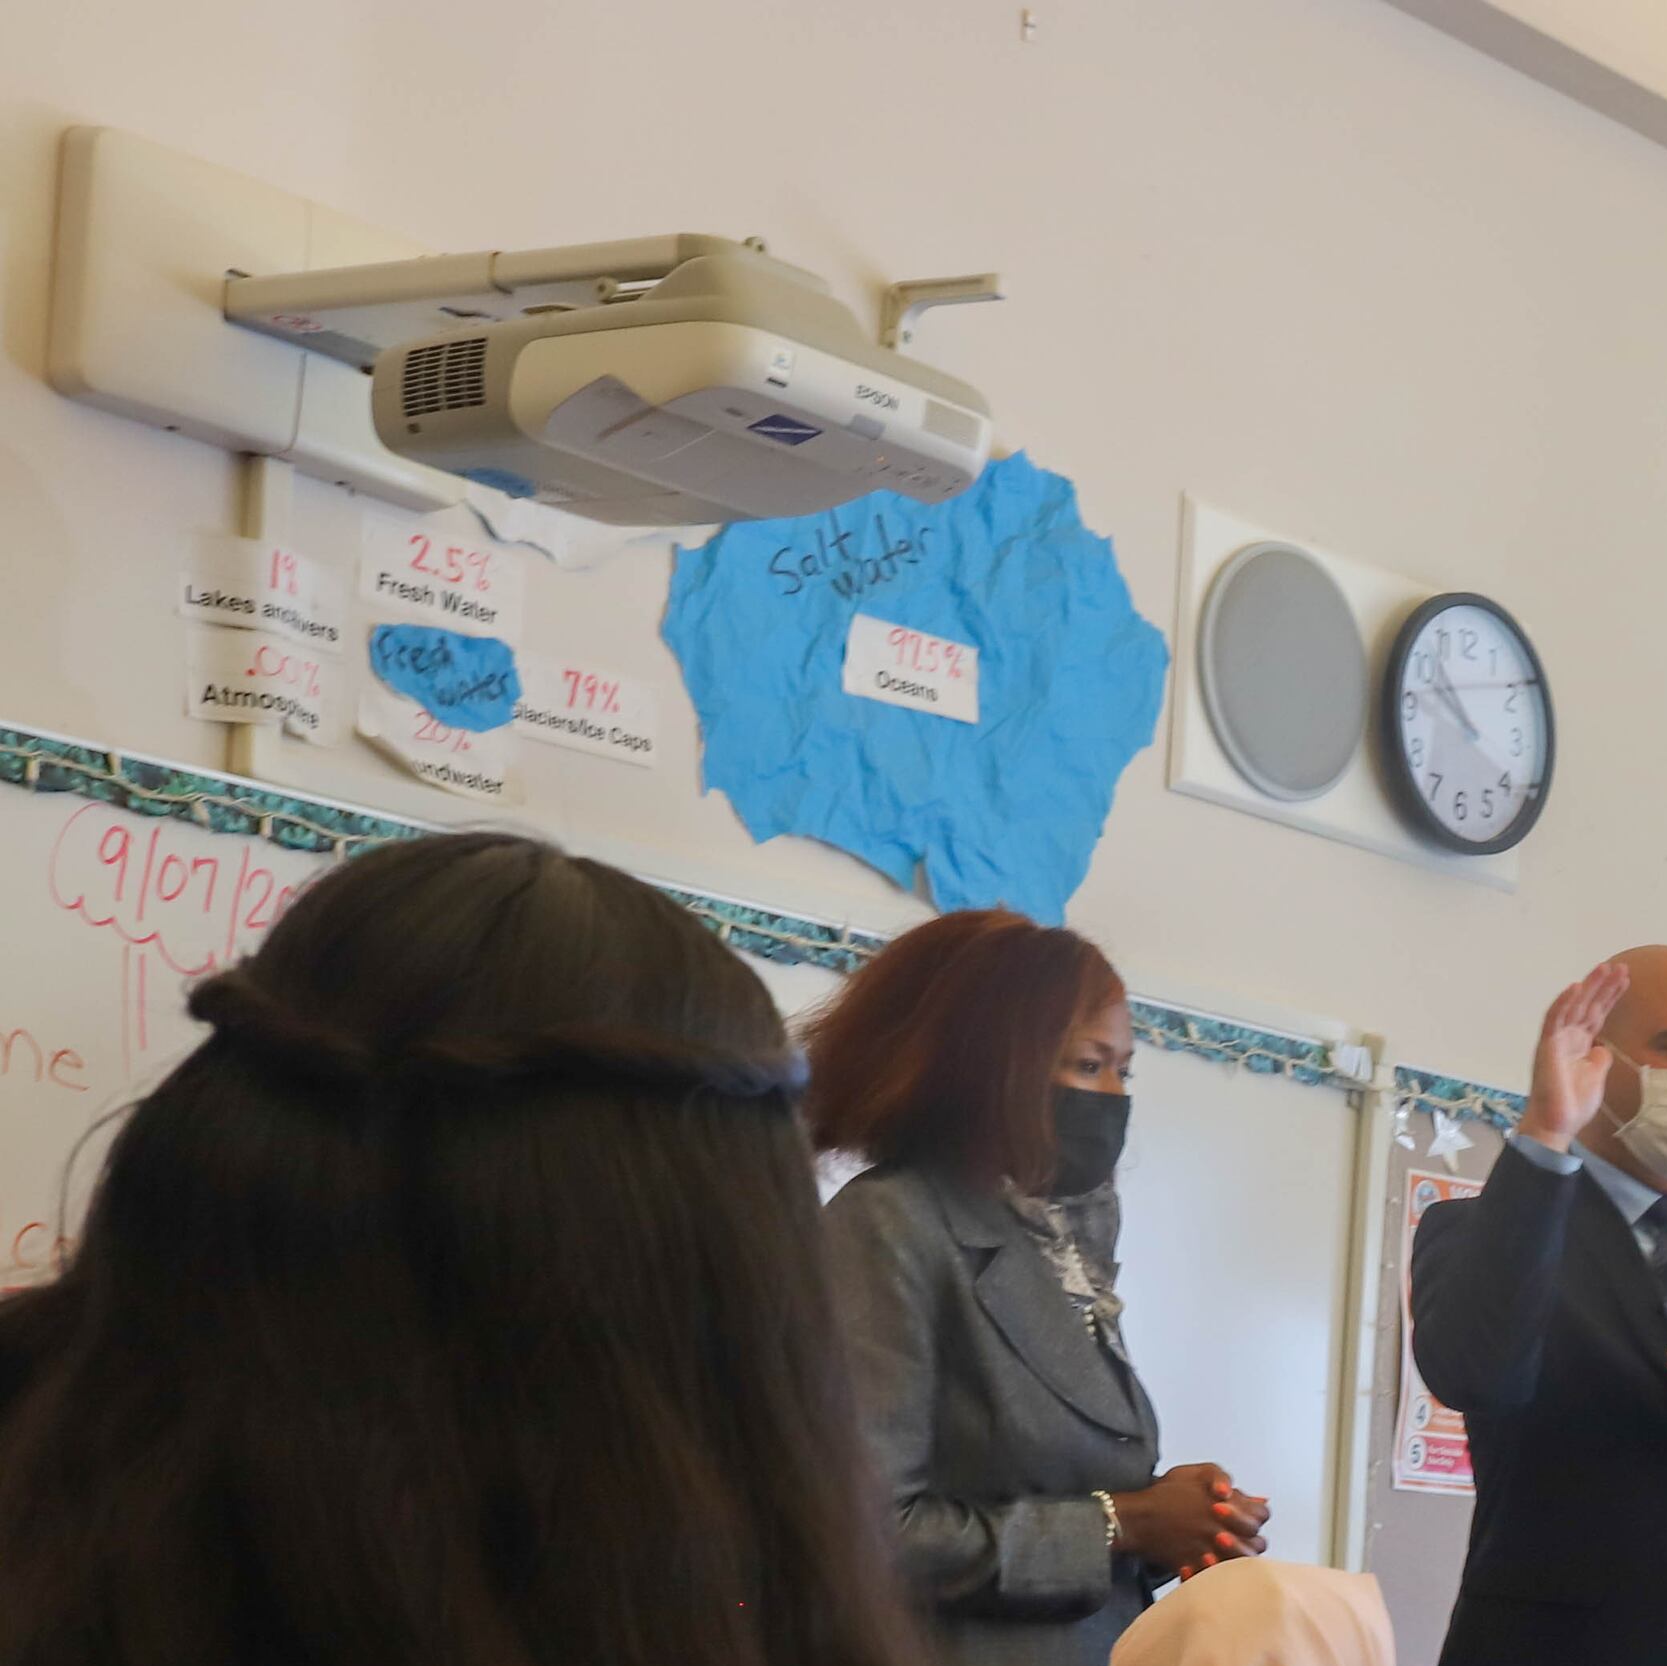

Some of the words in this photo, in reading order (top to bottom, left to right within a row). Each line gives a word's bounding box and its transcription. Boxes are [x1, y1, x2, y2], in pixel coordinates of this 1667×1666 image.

[409, 533, 491, 591] 2.5%
[768, 508, 853, 596] Salt
[831, 513, 934, 601] water
[185, 584, 256, 615] Lakes
[375, 572, 434, 607] Fresh
[441, 589, 498, 624] Water
[1458, 627, 1479, 662] 12
[1489, 648, 1497, 677] 1
[563, 669, 621, 714] 79%
[874, 670, 938, 702] Oceans
[1504, 683, 1519, 714] 2
[1403, 690, 1418, 722] 9
[609, 726, 653, 752] Caps
[1409, 737, 1424, 769] 8
[1511, 727, 1523, 758] 3
[1428, 772, 1444, 802] 7
[1498, 770, 1512, 798] 4
[1454, 790, 1469, 822] 6
[1480, 789, 1495, 820] 5
[1410, 1443, 1422, 1464] 5
